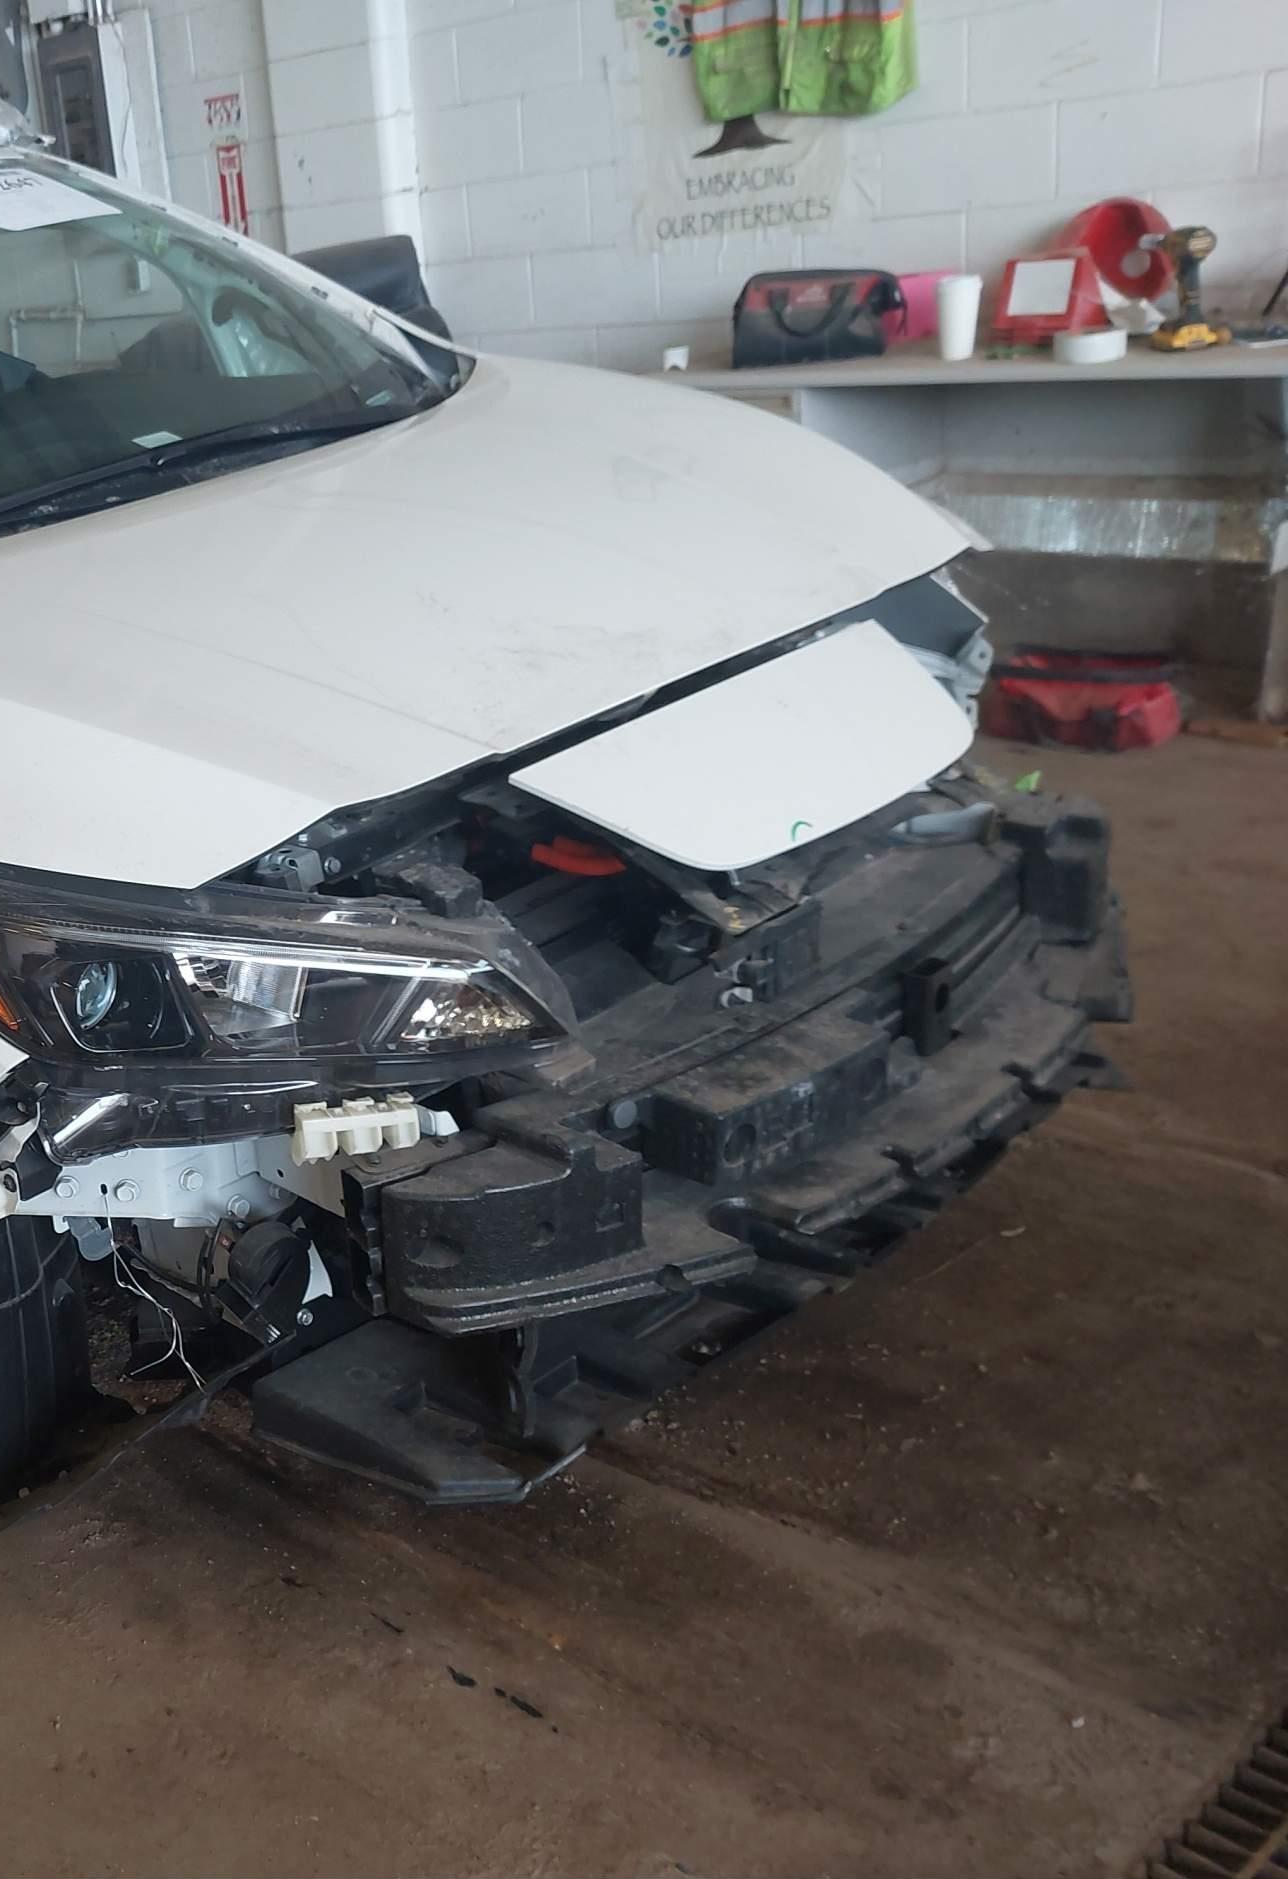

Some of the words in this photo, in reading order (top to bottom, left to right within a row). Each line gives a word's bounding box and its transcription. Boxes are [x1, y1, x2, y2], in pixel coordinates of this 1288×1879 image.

[686, 164, 795, 201] EMBRACING
[656, 212, 698, 241] OUR
[701, 198, 831, 236] DIFFERENCES
